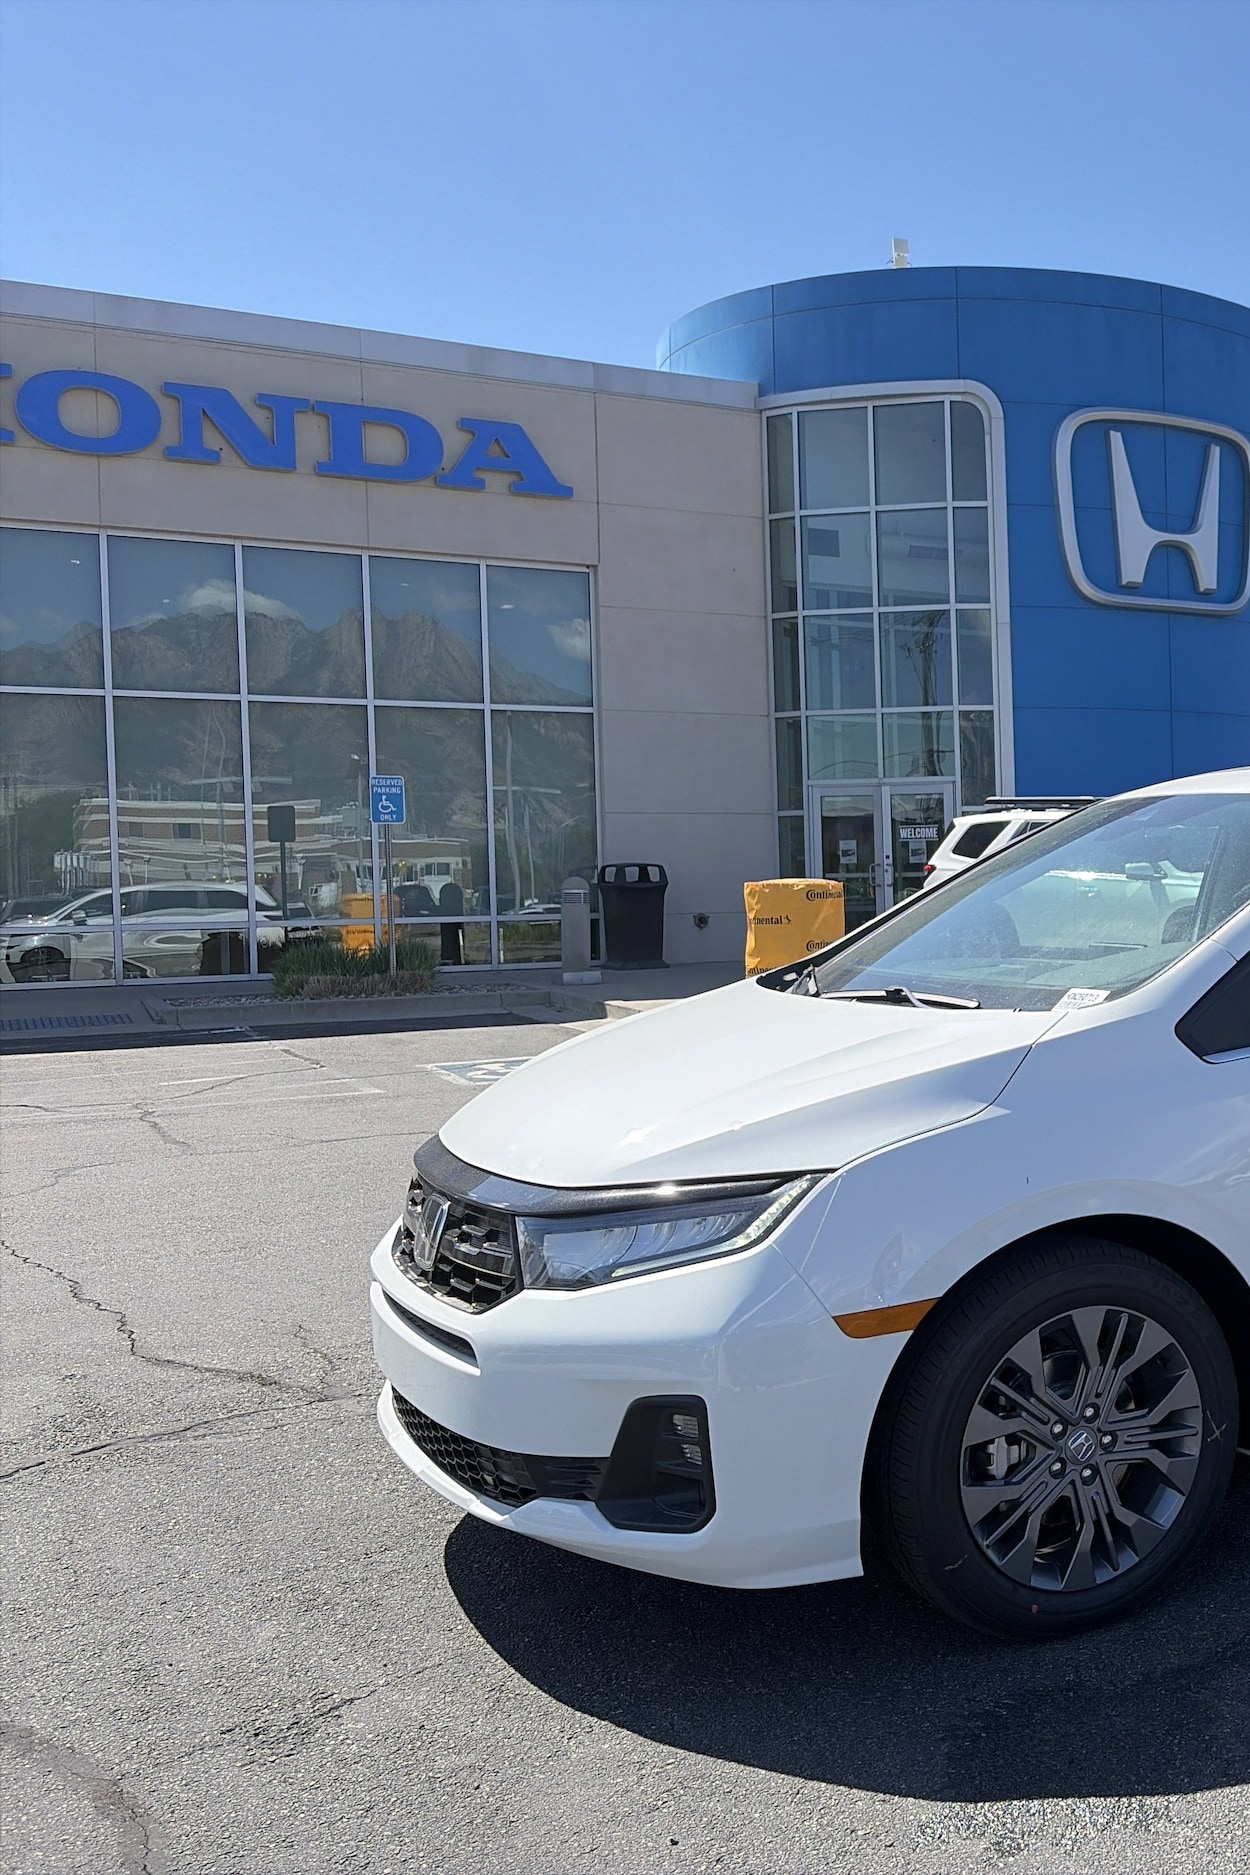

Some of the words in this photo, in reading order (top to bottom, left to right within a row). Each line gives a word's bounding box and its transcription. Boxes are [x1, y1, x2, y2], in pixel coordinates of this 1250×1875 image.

[0, 363, 574, 498] ONDA
[371, 778, 403, 786] RESERVED
[373, 786, 401, 794] PARKING
[899, 827, 938, 839] WELCOME
